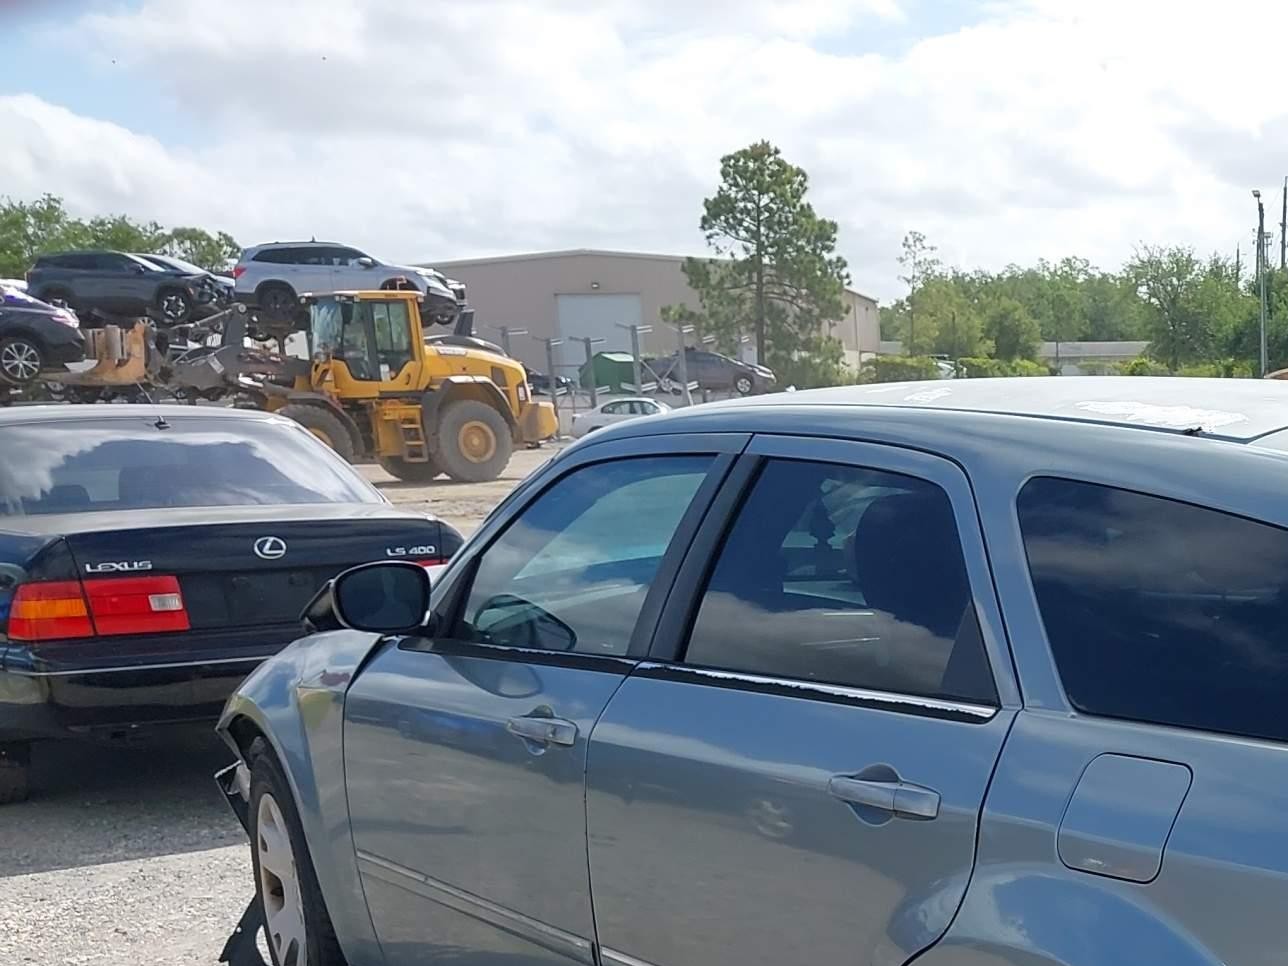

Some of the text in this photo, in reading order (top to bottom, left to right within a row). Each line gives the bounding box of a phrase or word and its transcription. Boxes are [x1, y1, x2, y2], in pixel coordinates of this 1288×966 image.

[386, 545, 436, 557] LS 400
[85, 560, 153, 573] LEXUS
